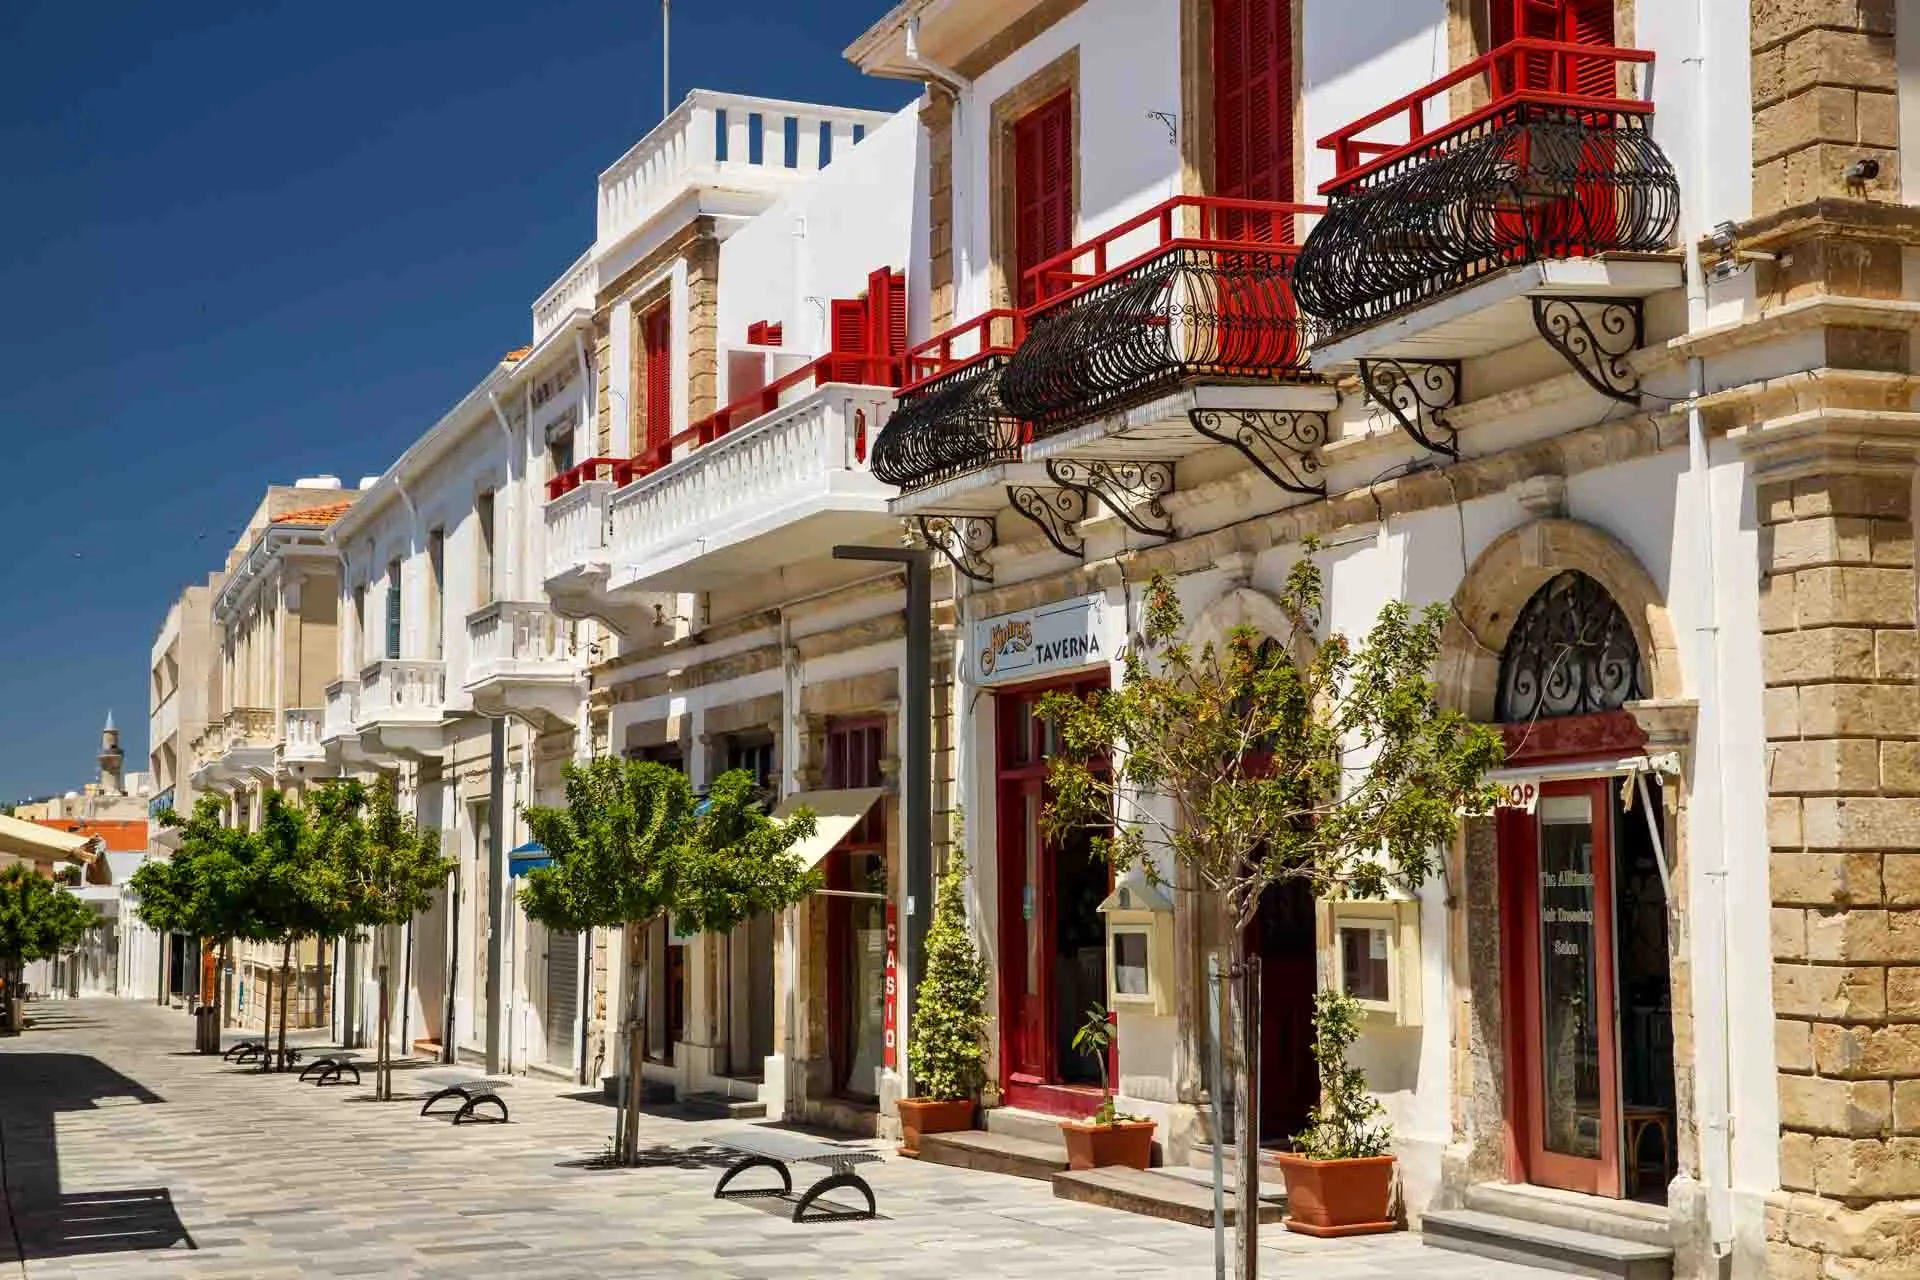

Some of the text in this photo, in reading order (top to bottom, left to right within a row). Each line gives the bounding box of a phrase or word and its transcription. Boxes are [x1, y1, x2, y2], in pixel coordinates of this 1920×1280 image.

[1036, 633, 1100, 664] TAVERNA
[1554, 939, 1579, 956] Salon
[886, 923, 896, 1048] CASIO
